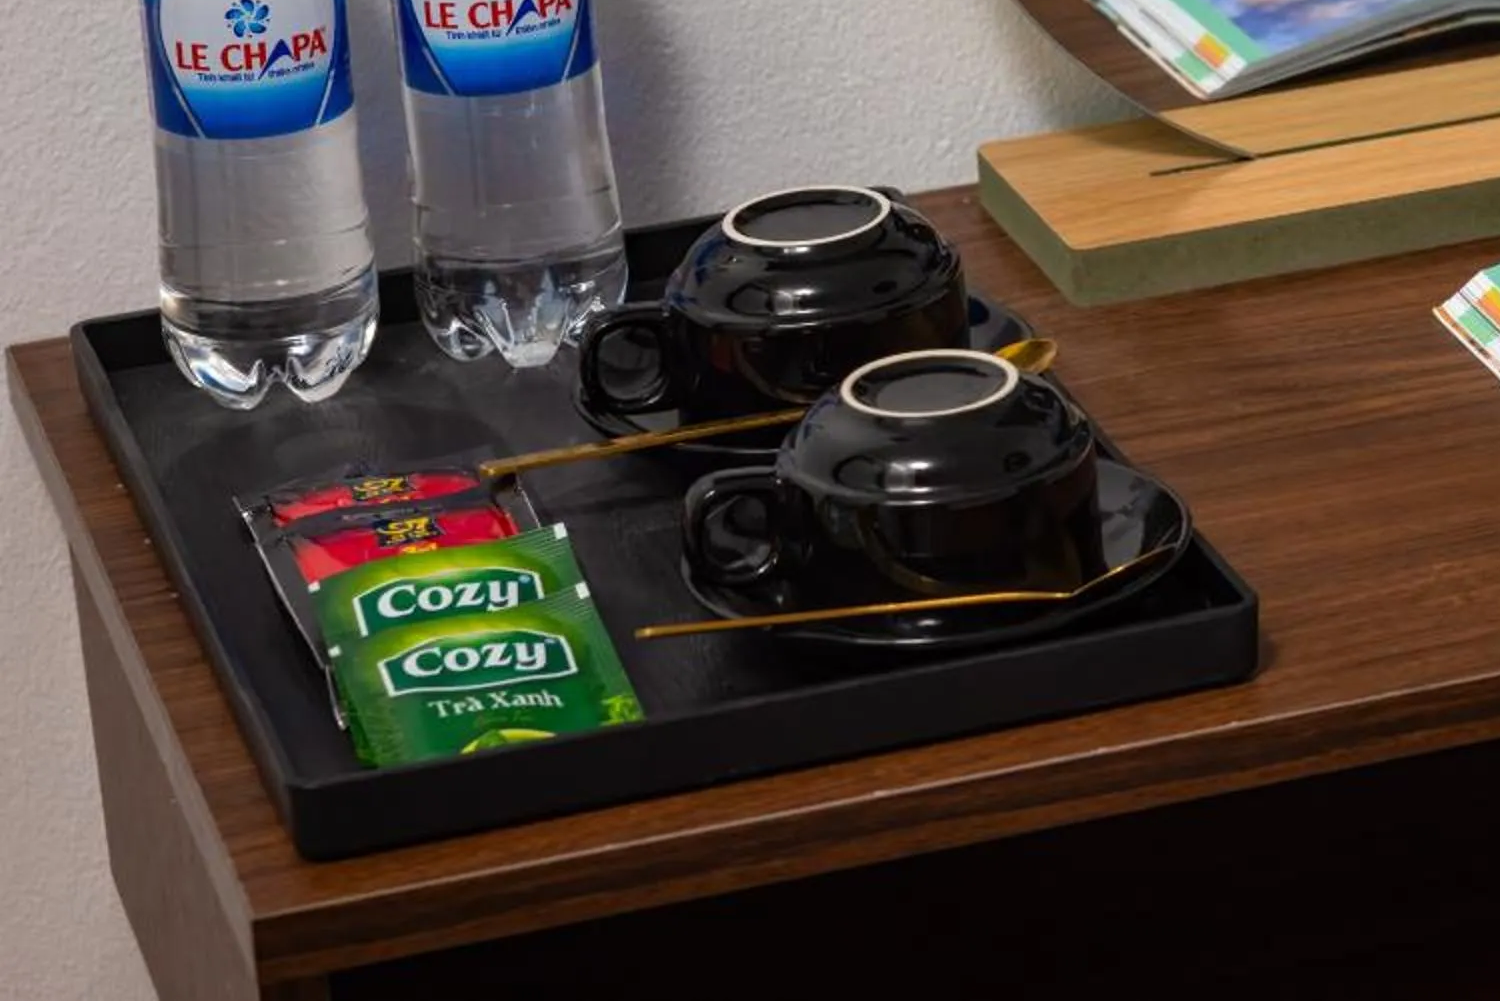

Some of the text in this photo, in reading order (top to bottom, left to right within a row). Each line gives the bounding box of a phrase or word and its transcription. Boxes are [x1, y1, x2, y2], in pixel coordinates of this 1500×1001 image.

[423, 0, 459, 29] LE
[175, 40, 211, 72] LE
[377, 579, 519, 618] Cozy
[402, 641, 547, 677] Cozy
[486, 687, 566, 709] Xanh
